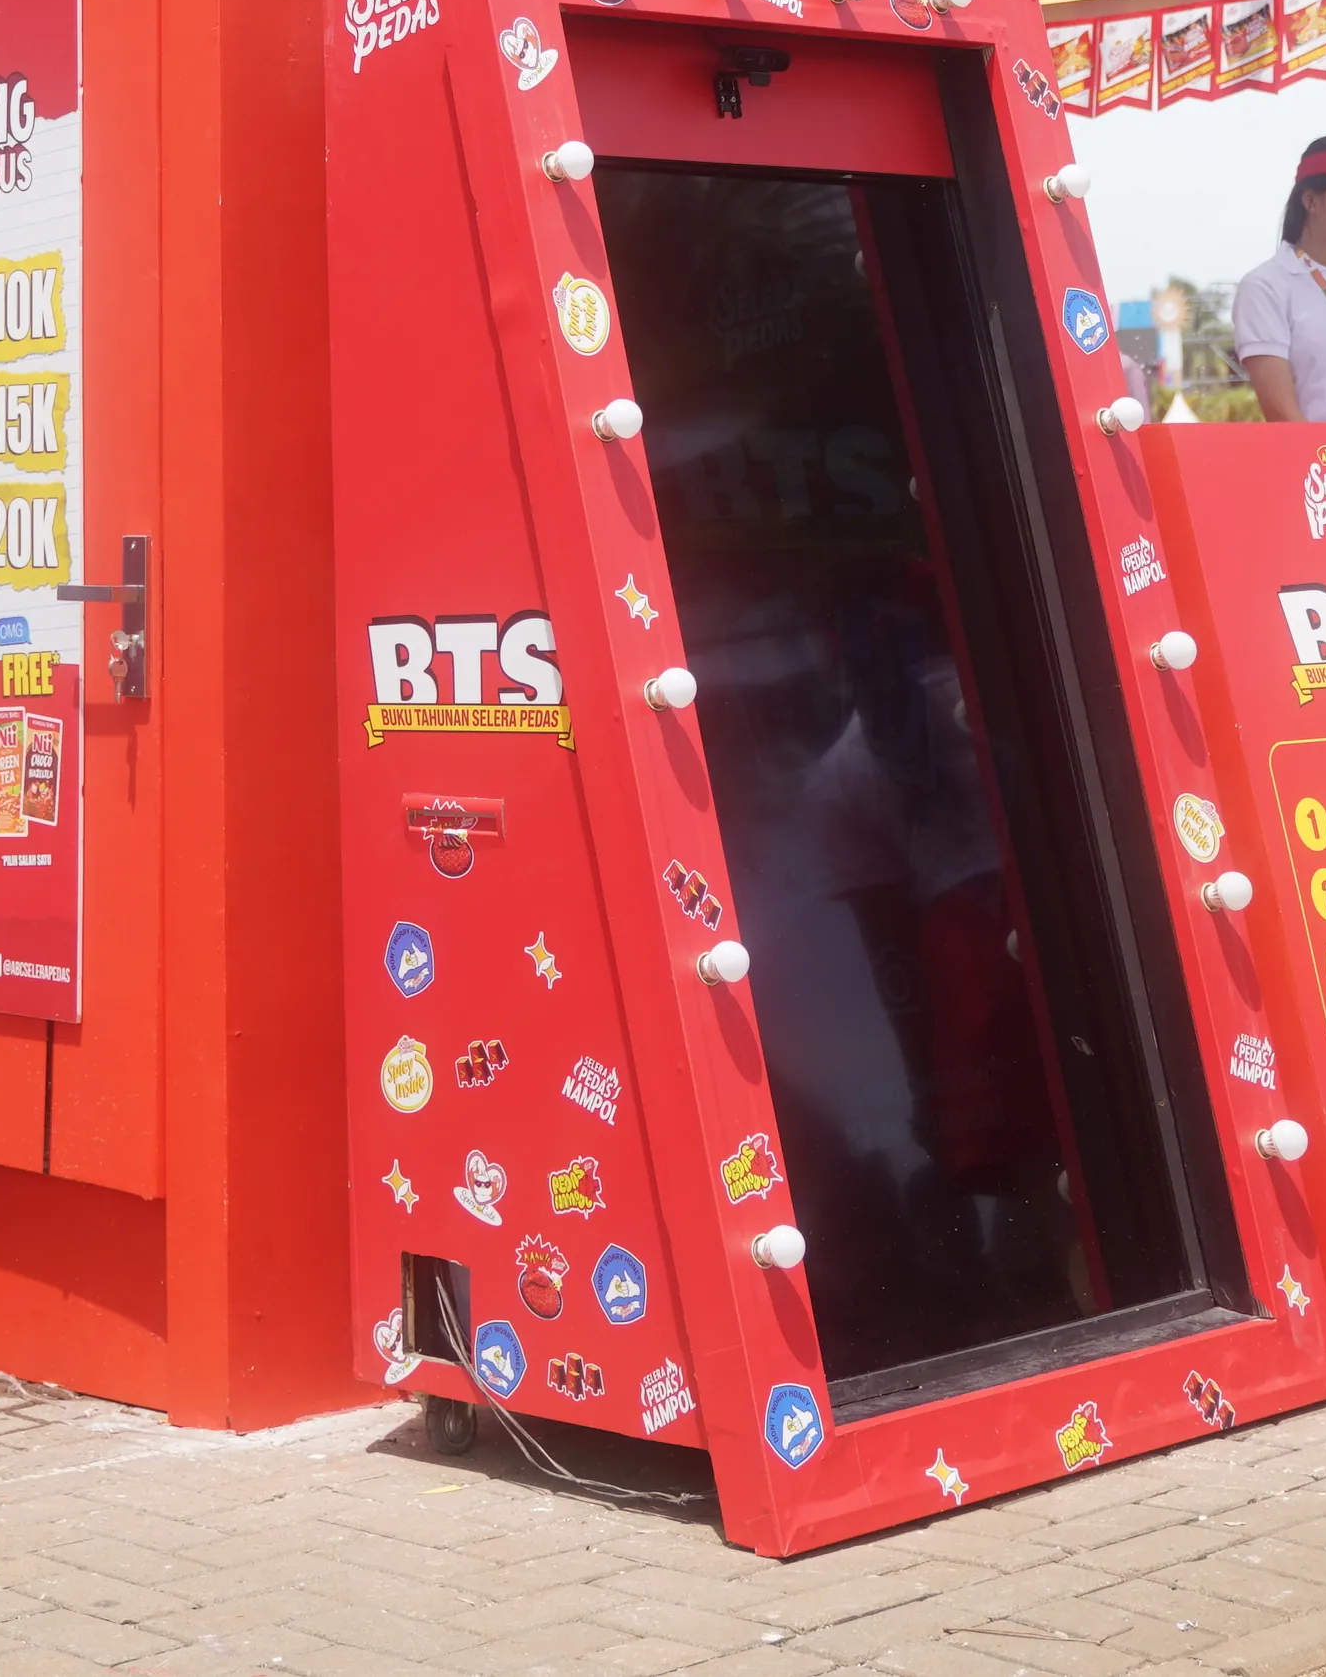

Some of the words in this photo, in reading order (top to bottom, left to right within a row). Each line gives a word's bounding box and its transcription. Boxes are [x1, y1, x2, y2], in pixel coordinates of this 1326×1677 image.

[1124, 552, 1151, 573] PEDAS
[1122, 560, 1167, 597] NAMPOL
[0, 622, 23, 640] OMG
[367, 613, 563, 705] BTS
[381, 709, 412, 726] BUKU
[414, 709, 469, 727] TAHUNAN
[472, 709, 516, 728] SELERA
[519, 710, 560, 728] PEDAS
[30, 753, 53, 768] CHOCO
[0, 770, 16, 785] TEA
[1180, 800, 1208, 830] Spicy
[1306, 808, 1320, 840] 1
[3, 959, 71, 984] @ABCSELERAPEDAS
[1239, 1033, 1262, 1049] SELERA
[584, 1056, 608, 1077] SELERA
[1238, 1042, 1267, 1067] PEDAS
[386, 1058, 414, 1084] Spicy
[577, 1066, 613, 1100] PEDAS
[1229, 1055, 1276, 1090] NAMPOL
[394, 1072, 425, 1100] Inside
[561, 1075, 618, 1126] NAMPOL
[642, 1365, 666, 1386] SELERA
[645, 1373, 679, 1405] PEDAS
[788, 1388, 811, 1407] HONEY
[642, 1386, 697, 1436] NAMPOL
